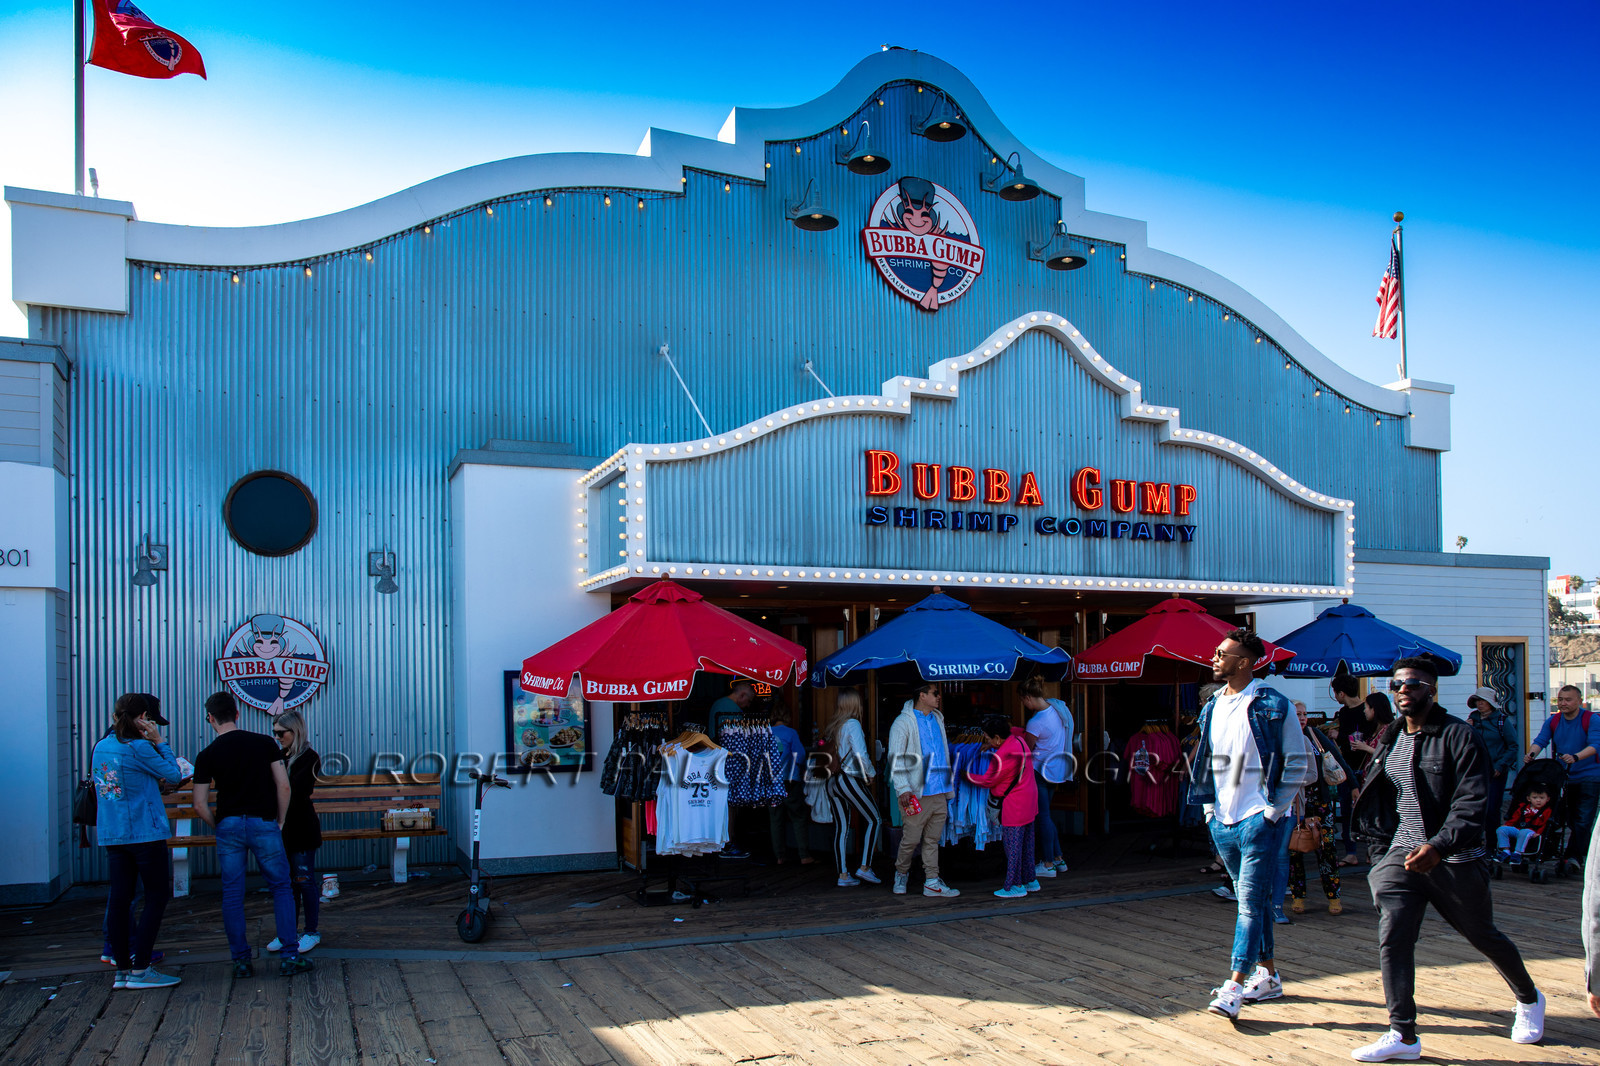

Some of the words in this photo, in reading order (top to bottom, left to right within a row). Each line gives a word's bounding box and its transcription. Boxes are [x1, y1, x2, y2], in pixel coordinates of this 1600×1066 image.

[869, 231, 929, 256] BUBBA
[932, 237, 981, 269] GUMP
[889, 258, 931, 270] SHRIMP
[877, 257, 922, 299] RESTAURANT
[948, 274, 974, 299] MARKET
[865, 449, 1044, 506] BUBBA
[1072, 466, 1198, 516] GUMP
[866, 506, 1019, 533] SHRIMP
[1036, 516, 1198, 543] COMPANY
[222, 661, 277, 678] BUBBA
[281, 659, 327, 680] GUMP
[928, 663, 980, 676] SHRIMP
[984, 662, 1008, 675] CO.
[1077, 662, 1108, 674] BUBBA
[1110, 661, 1140, 672] GUMP
[1269, 661, 1309, 672] SIMP
[1310, 662, 1329, 673] CO.
[239, 679, 279, 687] SHRIMP
[522, 671, 554, 690] SHRIMP
[552, 676, 565, 691] CO.
[586, 680, 639, 696] BUBBA
[643, 679, 688, 695] GUMP
[229, 680, 269, 709] RESTAURANT
[293, 684, 318, 705] MARKET
[681, 771, 701, 790] BUBBA
[704, 772, 718, 791] GUMP
[691, 782, 710, 798] 75
